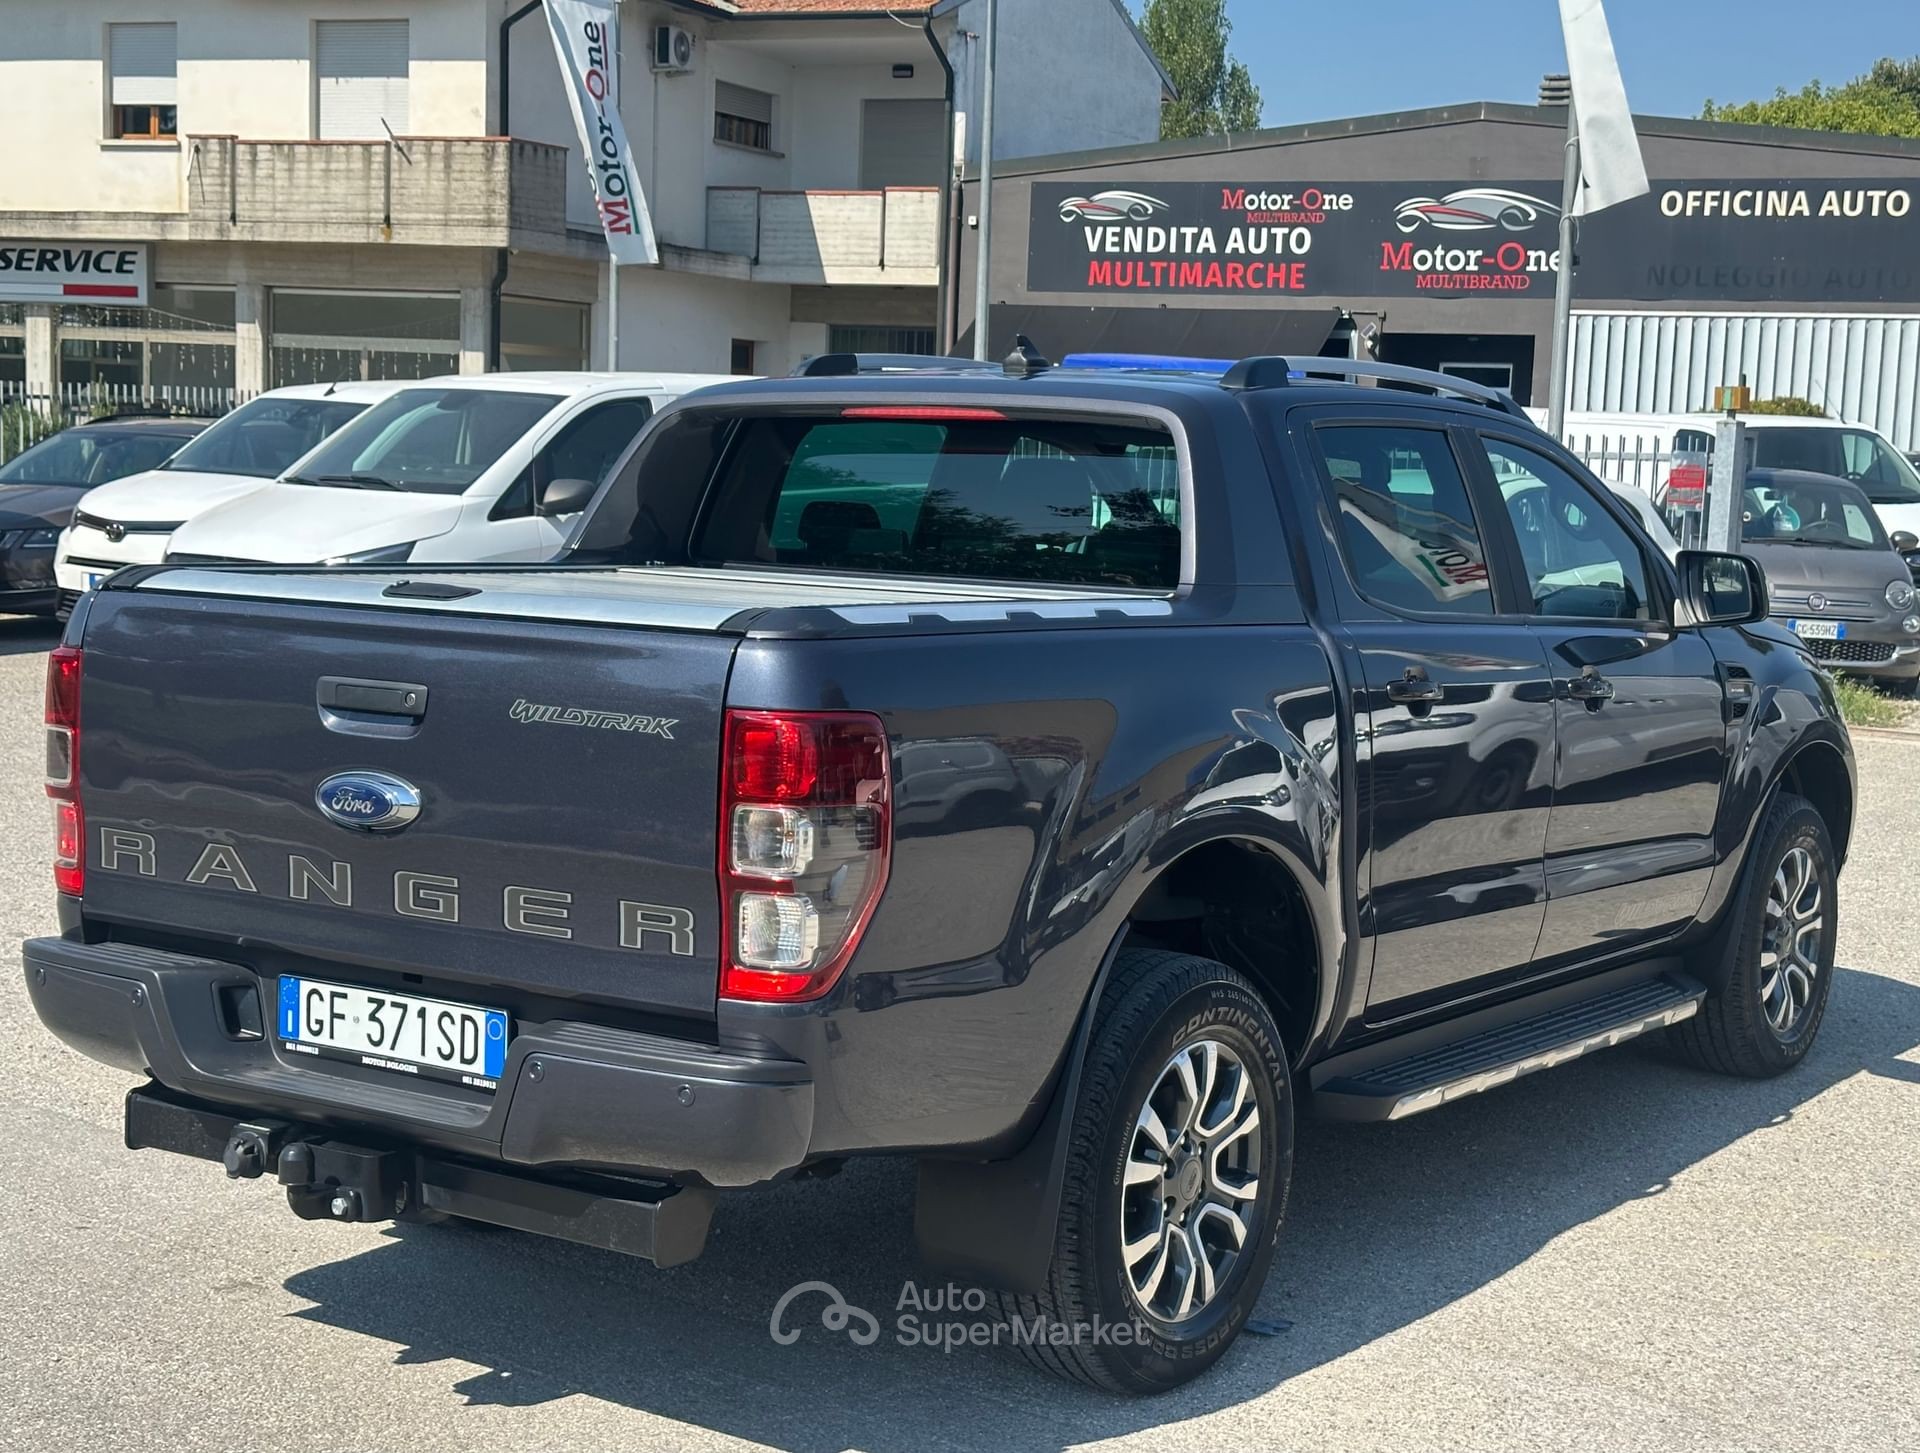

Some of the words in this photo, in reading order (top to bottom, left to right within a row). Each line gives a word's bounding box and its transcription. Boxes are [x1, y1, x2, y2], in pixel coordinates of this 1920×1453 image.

[584, 20, 632, 236] Motor-One
[1221, 188, 1353, 211] Motor-One
[1660, 190, 1810, 217] OFFICINA
[1818, 190, 1911, 217] AUTO
[1246, 212, 1326, 224] MULTIBRAND
[1083, 226, 1217, 254] VENDITA
[1224, 227, 1312, 255] AUTO
[0, 248, 138, 274] SERVICE
[1380, 241, 1562, 273] Motor-One
[1087, 261, 1306, 289] MULTIMARCHE
[1416, 274, 1530, 290] MULTIBRAND
[1648, 264, 1811, 288] NOLEGGIO
[1823, 265, 1912, 290] AUTO
[509, 699, 680, 739] WILDTRAK
[332, 786, 377, 814] Ford
[99, 826, 694, 957] RANGER
[305, 987, 349, 1041] GF
[365, 996, 480, 1067] 371SD
[1171, 1005, 1285, 1101] CONTINENTAL
